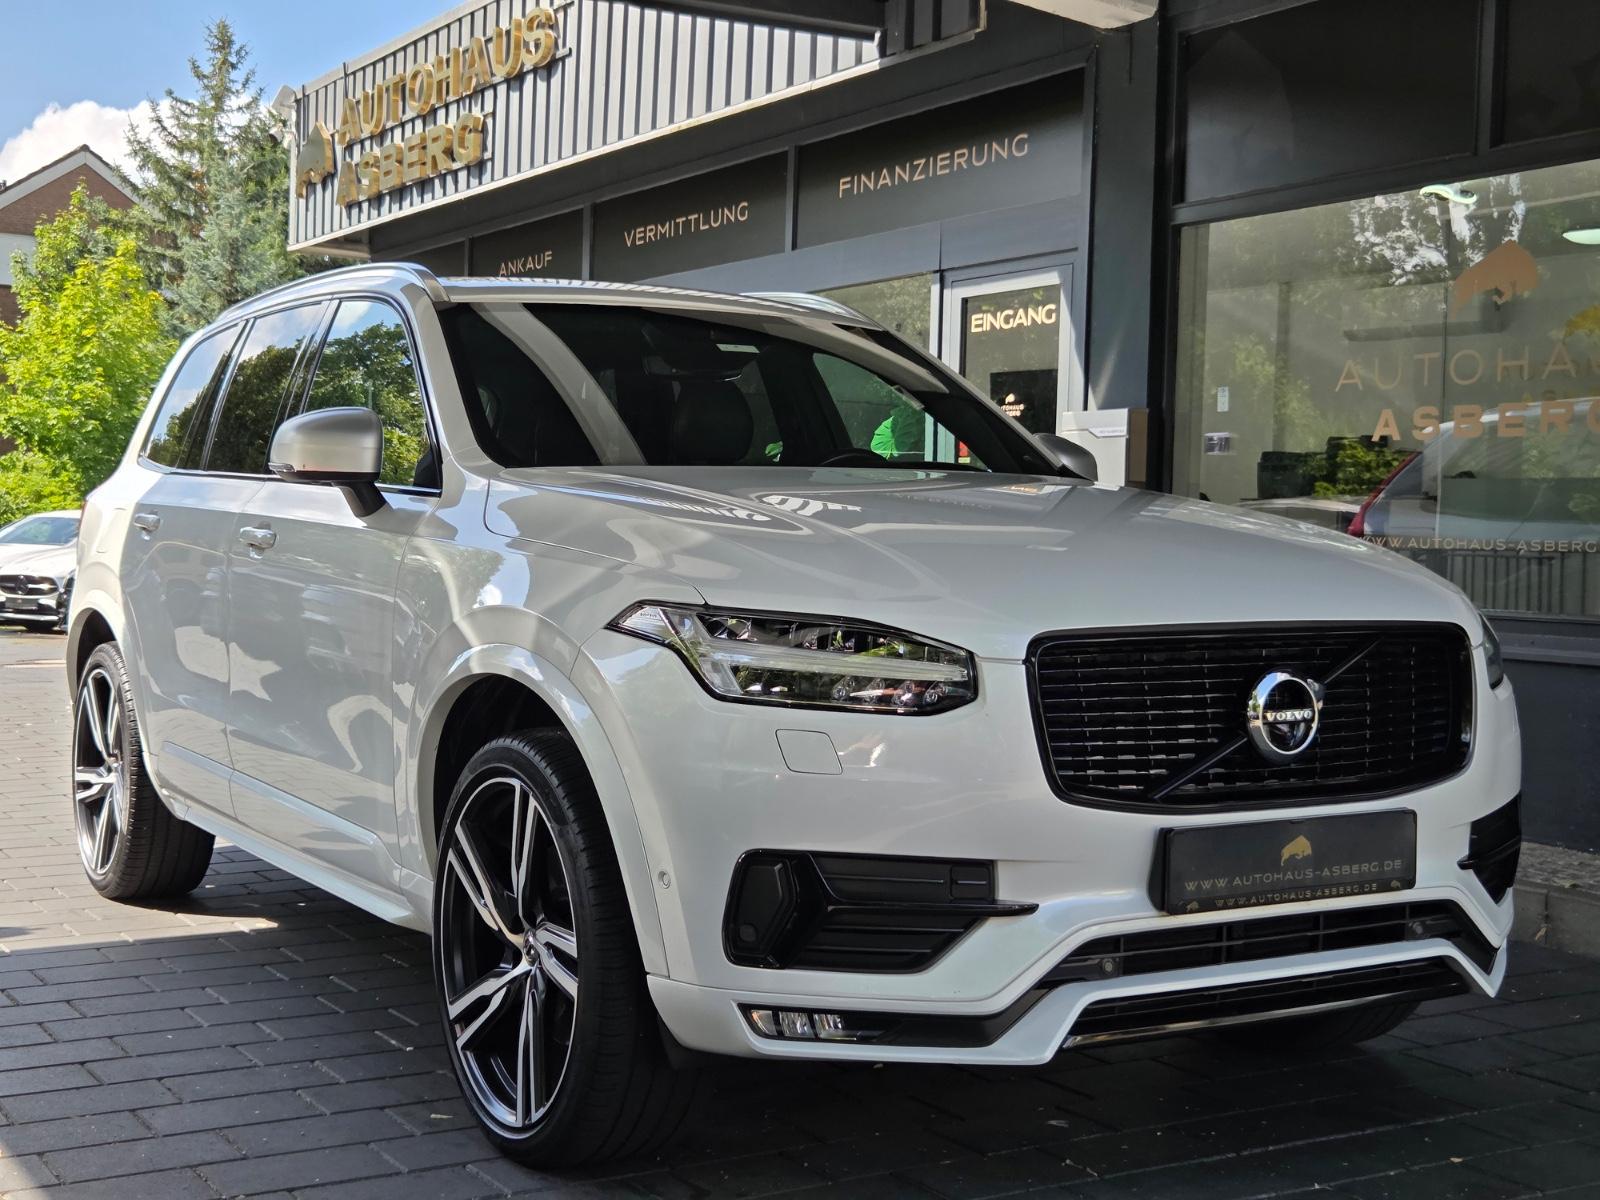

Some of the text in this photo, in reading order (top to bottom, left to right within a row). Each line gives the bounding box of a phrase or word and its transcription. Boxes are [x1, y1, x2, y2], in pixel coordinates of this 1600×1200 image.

[338, 7, 556, 148] AUTOHAUS
[336, 112, 484, 208] ASBERG
[839, 132, 1030, 198] FINANZIERUNG
[624, 201, 749, 248] VERMITTLUNG
[499, 250, 552, 277] ANKAUF
[970, 303, 1057, 333] EINGANG
[1264, 710, 1313, 721] VOLVO
[1184, 858, 1402, 891] WWW.AUTOHAUS-ASBERG.DE
[1215, 883, 1378, 908] WWW.AUTOHAUS-ASBERG.DE
